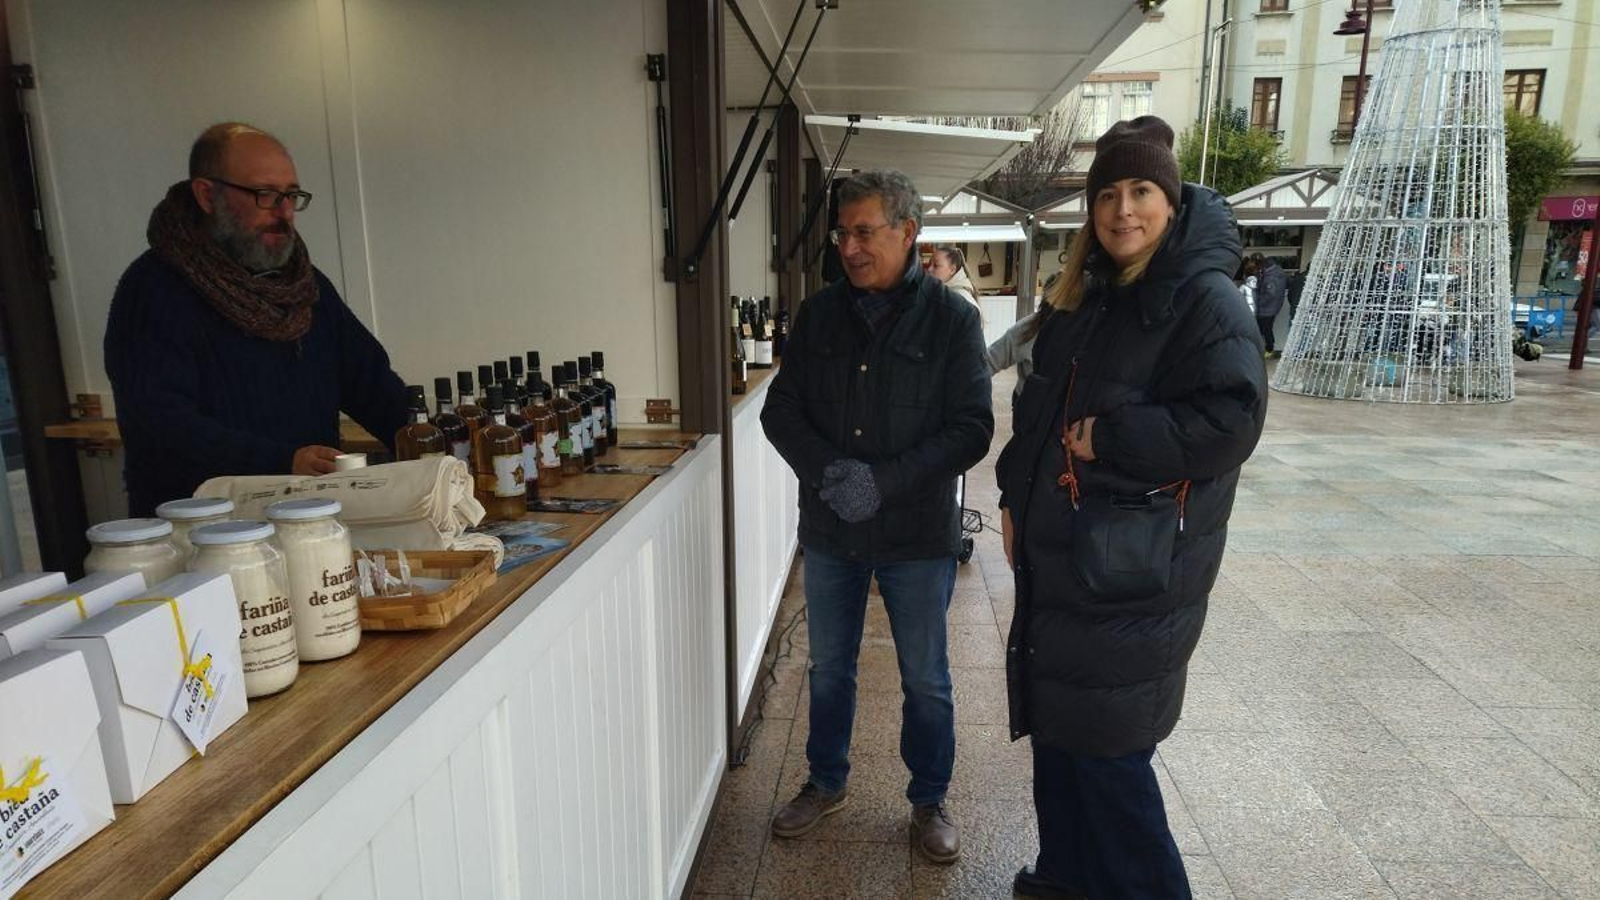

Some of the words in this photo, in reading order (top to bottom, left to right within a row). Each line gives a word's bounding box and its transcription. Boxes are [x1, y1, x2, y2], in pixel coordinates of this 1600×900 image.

[240, 597, 290, 621] fariña
[309, 591, 329, 607] de
[239, 627, 248, 640] e
[6, 788, 60, 839] castaña
